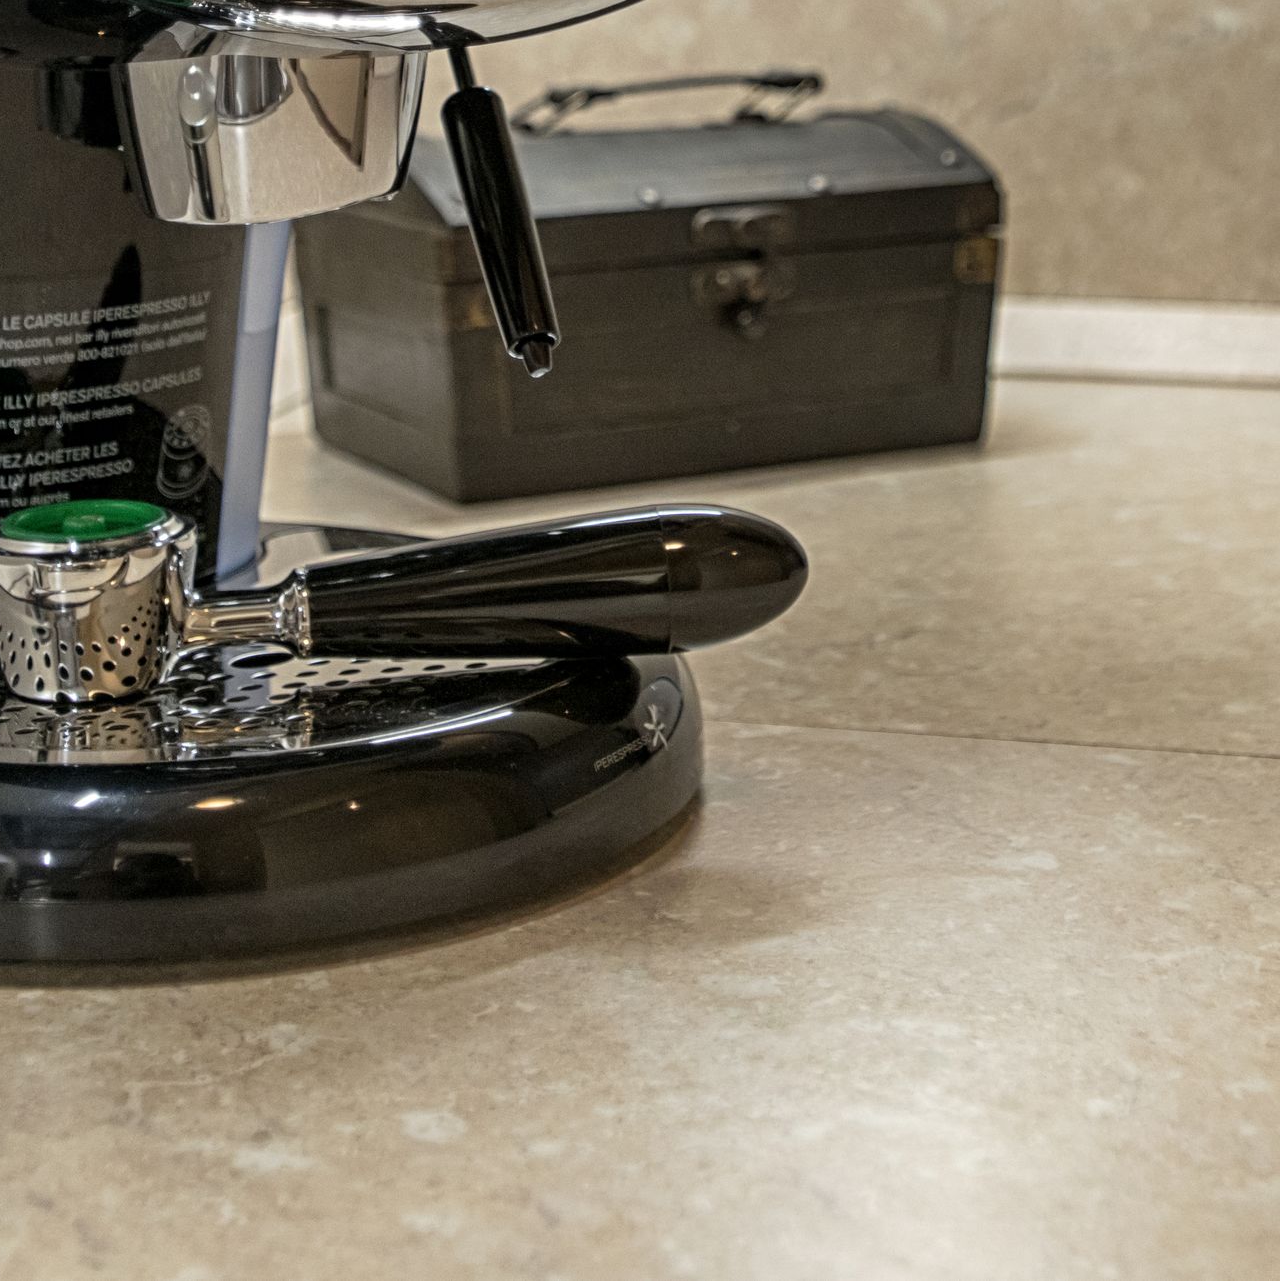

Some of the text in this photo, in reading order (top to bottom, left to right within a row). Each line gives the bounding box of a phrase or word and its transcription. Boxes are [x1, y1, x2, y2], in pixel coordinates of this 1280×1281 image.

[2, 316, 21, 331] LE
[23, 310, 91, 329] CAPSULE
[93, 296, 188, 323] IPERESPRESSO
[189, 291, 210, 308] ILLY
[75, 332, 94, 344] bar
[95, 328, 110, 343] illy
[42, 351, 75, 365] verde
[3, 394, 33, 410] ILLY
[36, 381, 140, 409] IPERESPRESSO
[142, 367, 203, 393] CAPSULES
[23, 415, 36, 428] at
[23, 445, 91, 467] ACHETER
[93, 440, 119, 458] LES
[28, 457, 135, 487] IPERESPRESSO
[11, 497, 27, 508] ou
